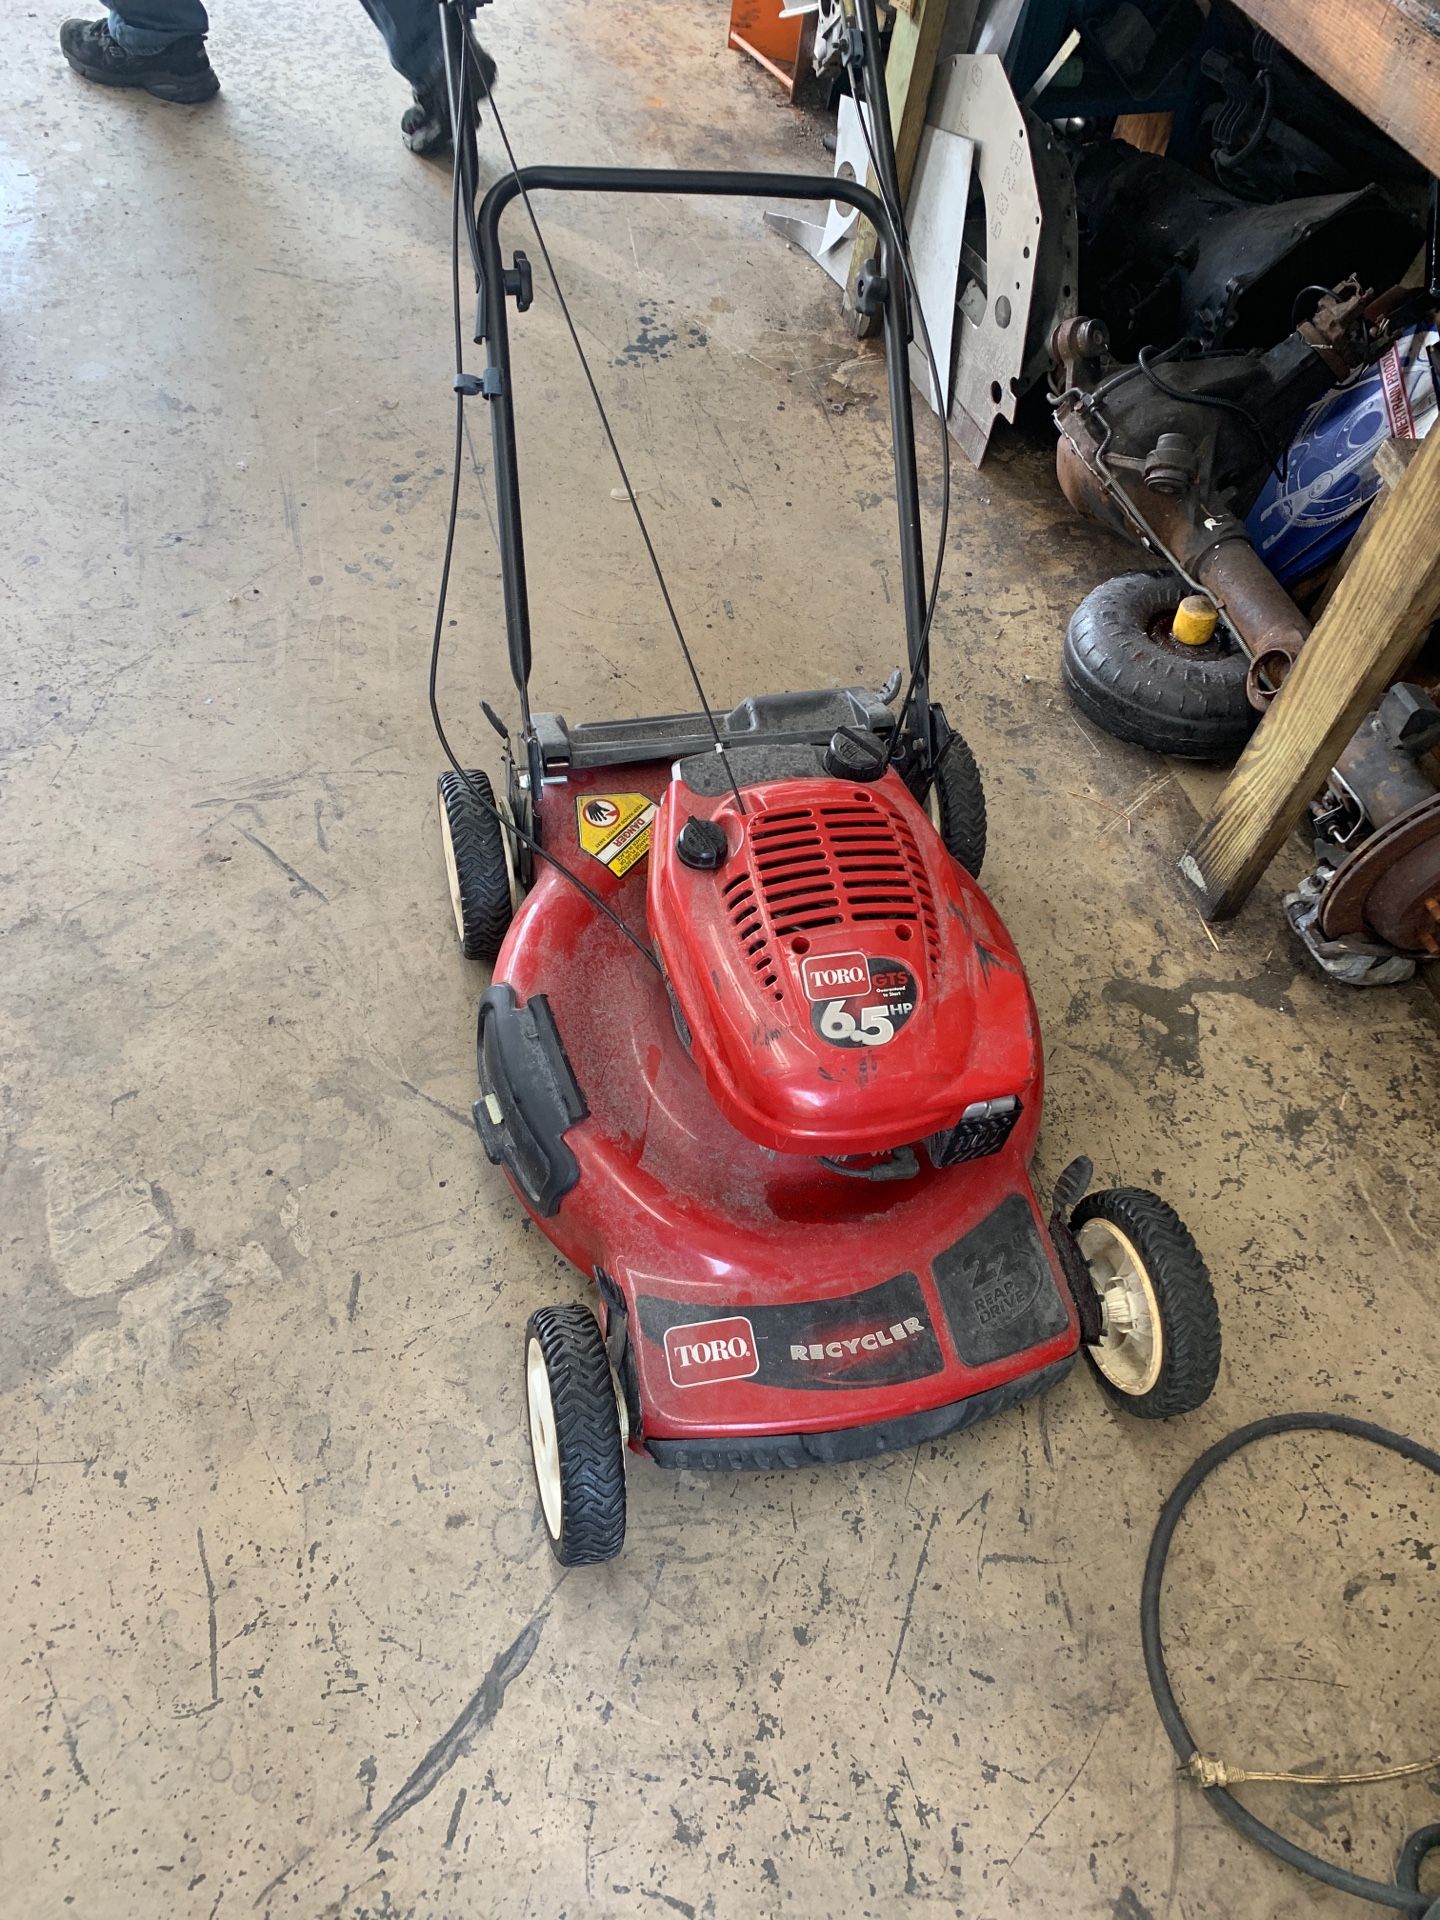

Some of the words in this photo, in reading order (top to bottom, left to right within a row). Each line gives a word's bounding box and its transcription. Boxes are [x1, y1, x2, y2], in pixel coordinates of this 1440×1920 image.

[613, 817, 646, 848] DANGER
[810, 967, 864, 987] TORO
[872, 972, 907, 986] GTS
[820, 1000, 895, 1046] 6.5
[889, 1002, 913, 1015] HP
[980, 1291, 1025, 1325] DRIVE
[674, 1337, 750, 1368] TORO
[790, 1316, 925, 1361] RECYCLER
